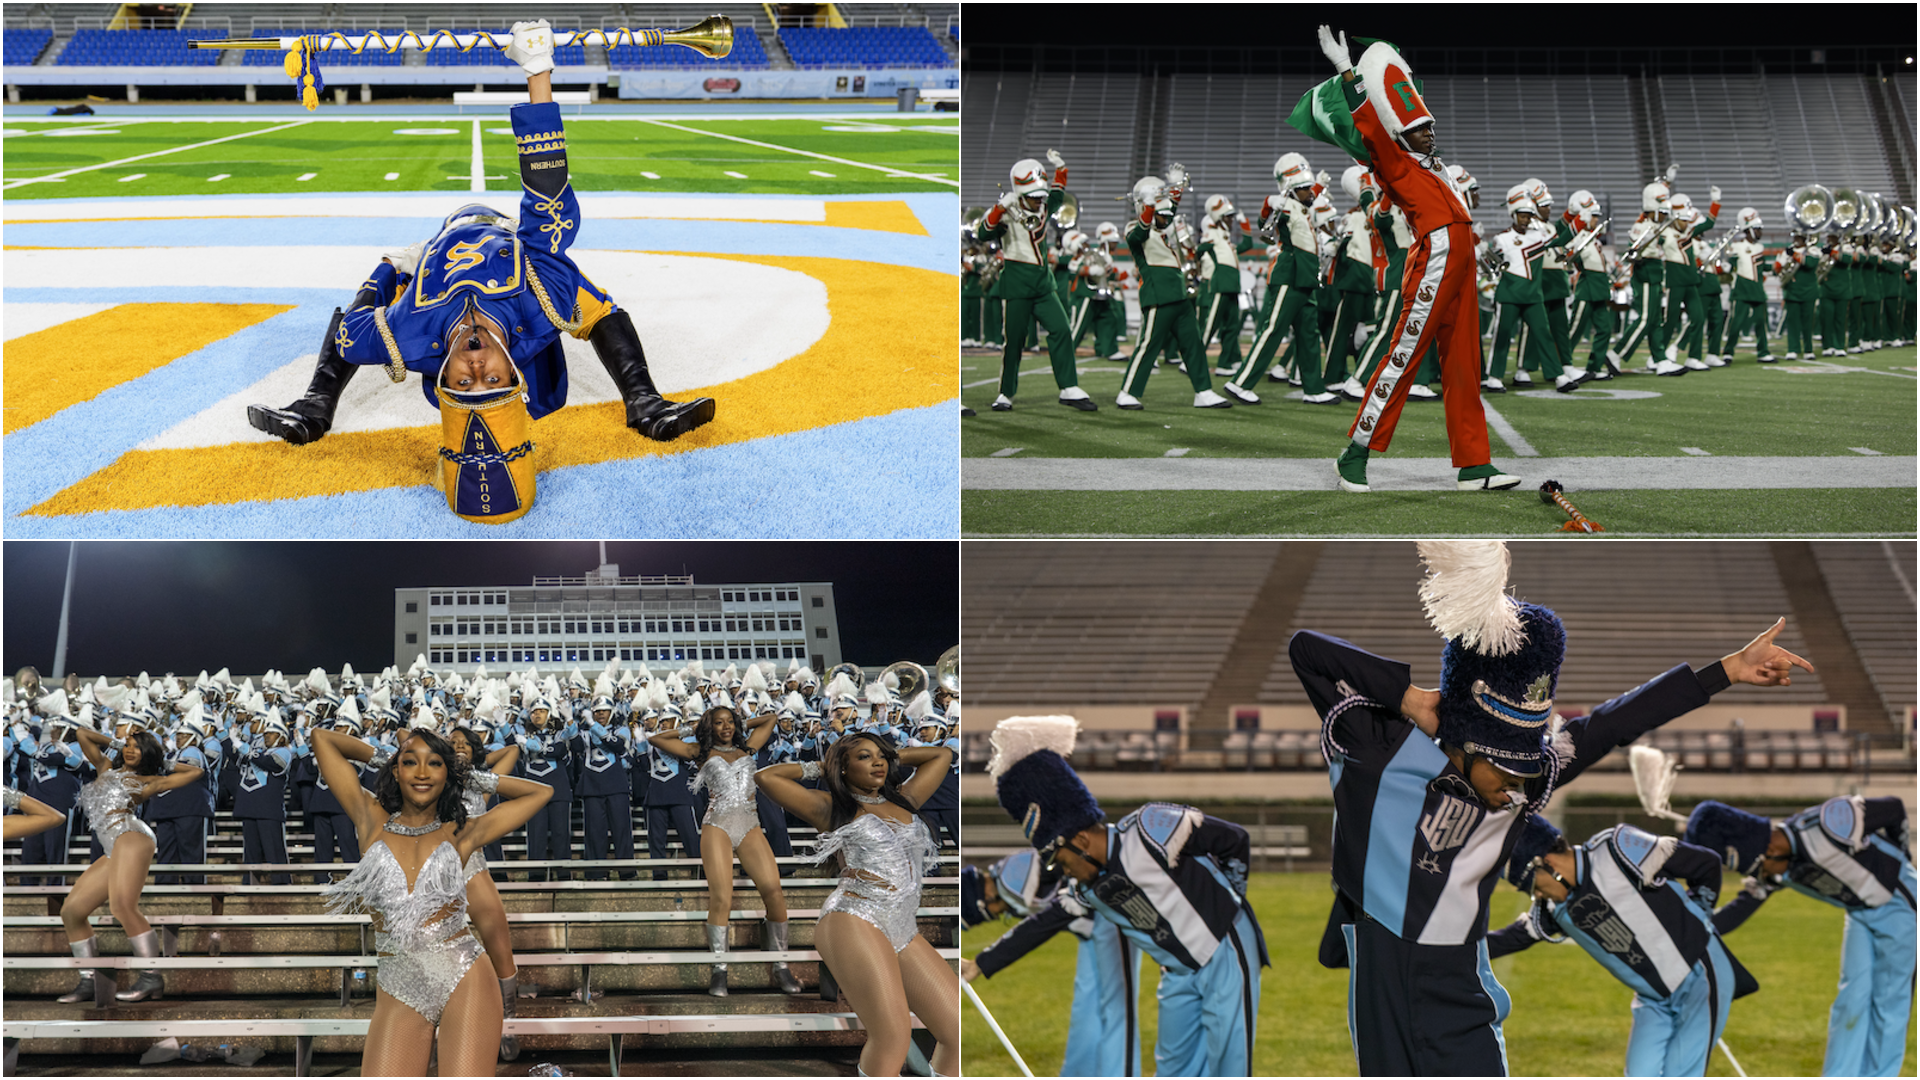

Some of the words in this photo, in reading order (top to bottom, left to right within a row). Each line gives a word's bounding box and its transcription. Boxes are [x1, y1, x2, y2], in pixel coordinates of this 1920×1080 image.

[1392, 81, 1416, 112] F
[530, 159, 566, 170] SOUTHERN
[443, 235, 495, 283] S
[1420, 794, 1480, 853] JSU
[1594, 915, 1634, 953] JSU
